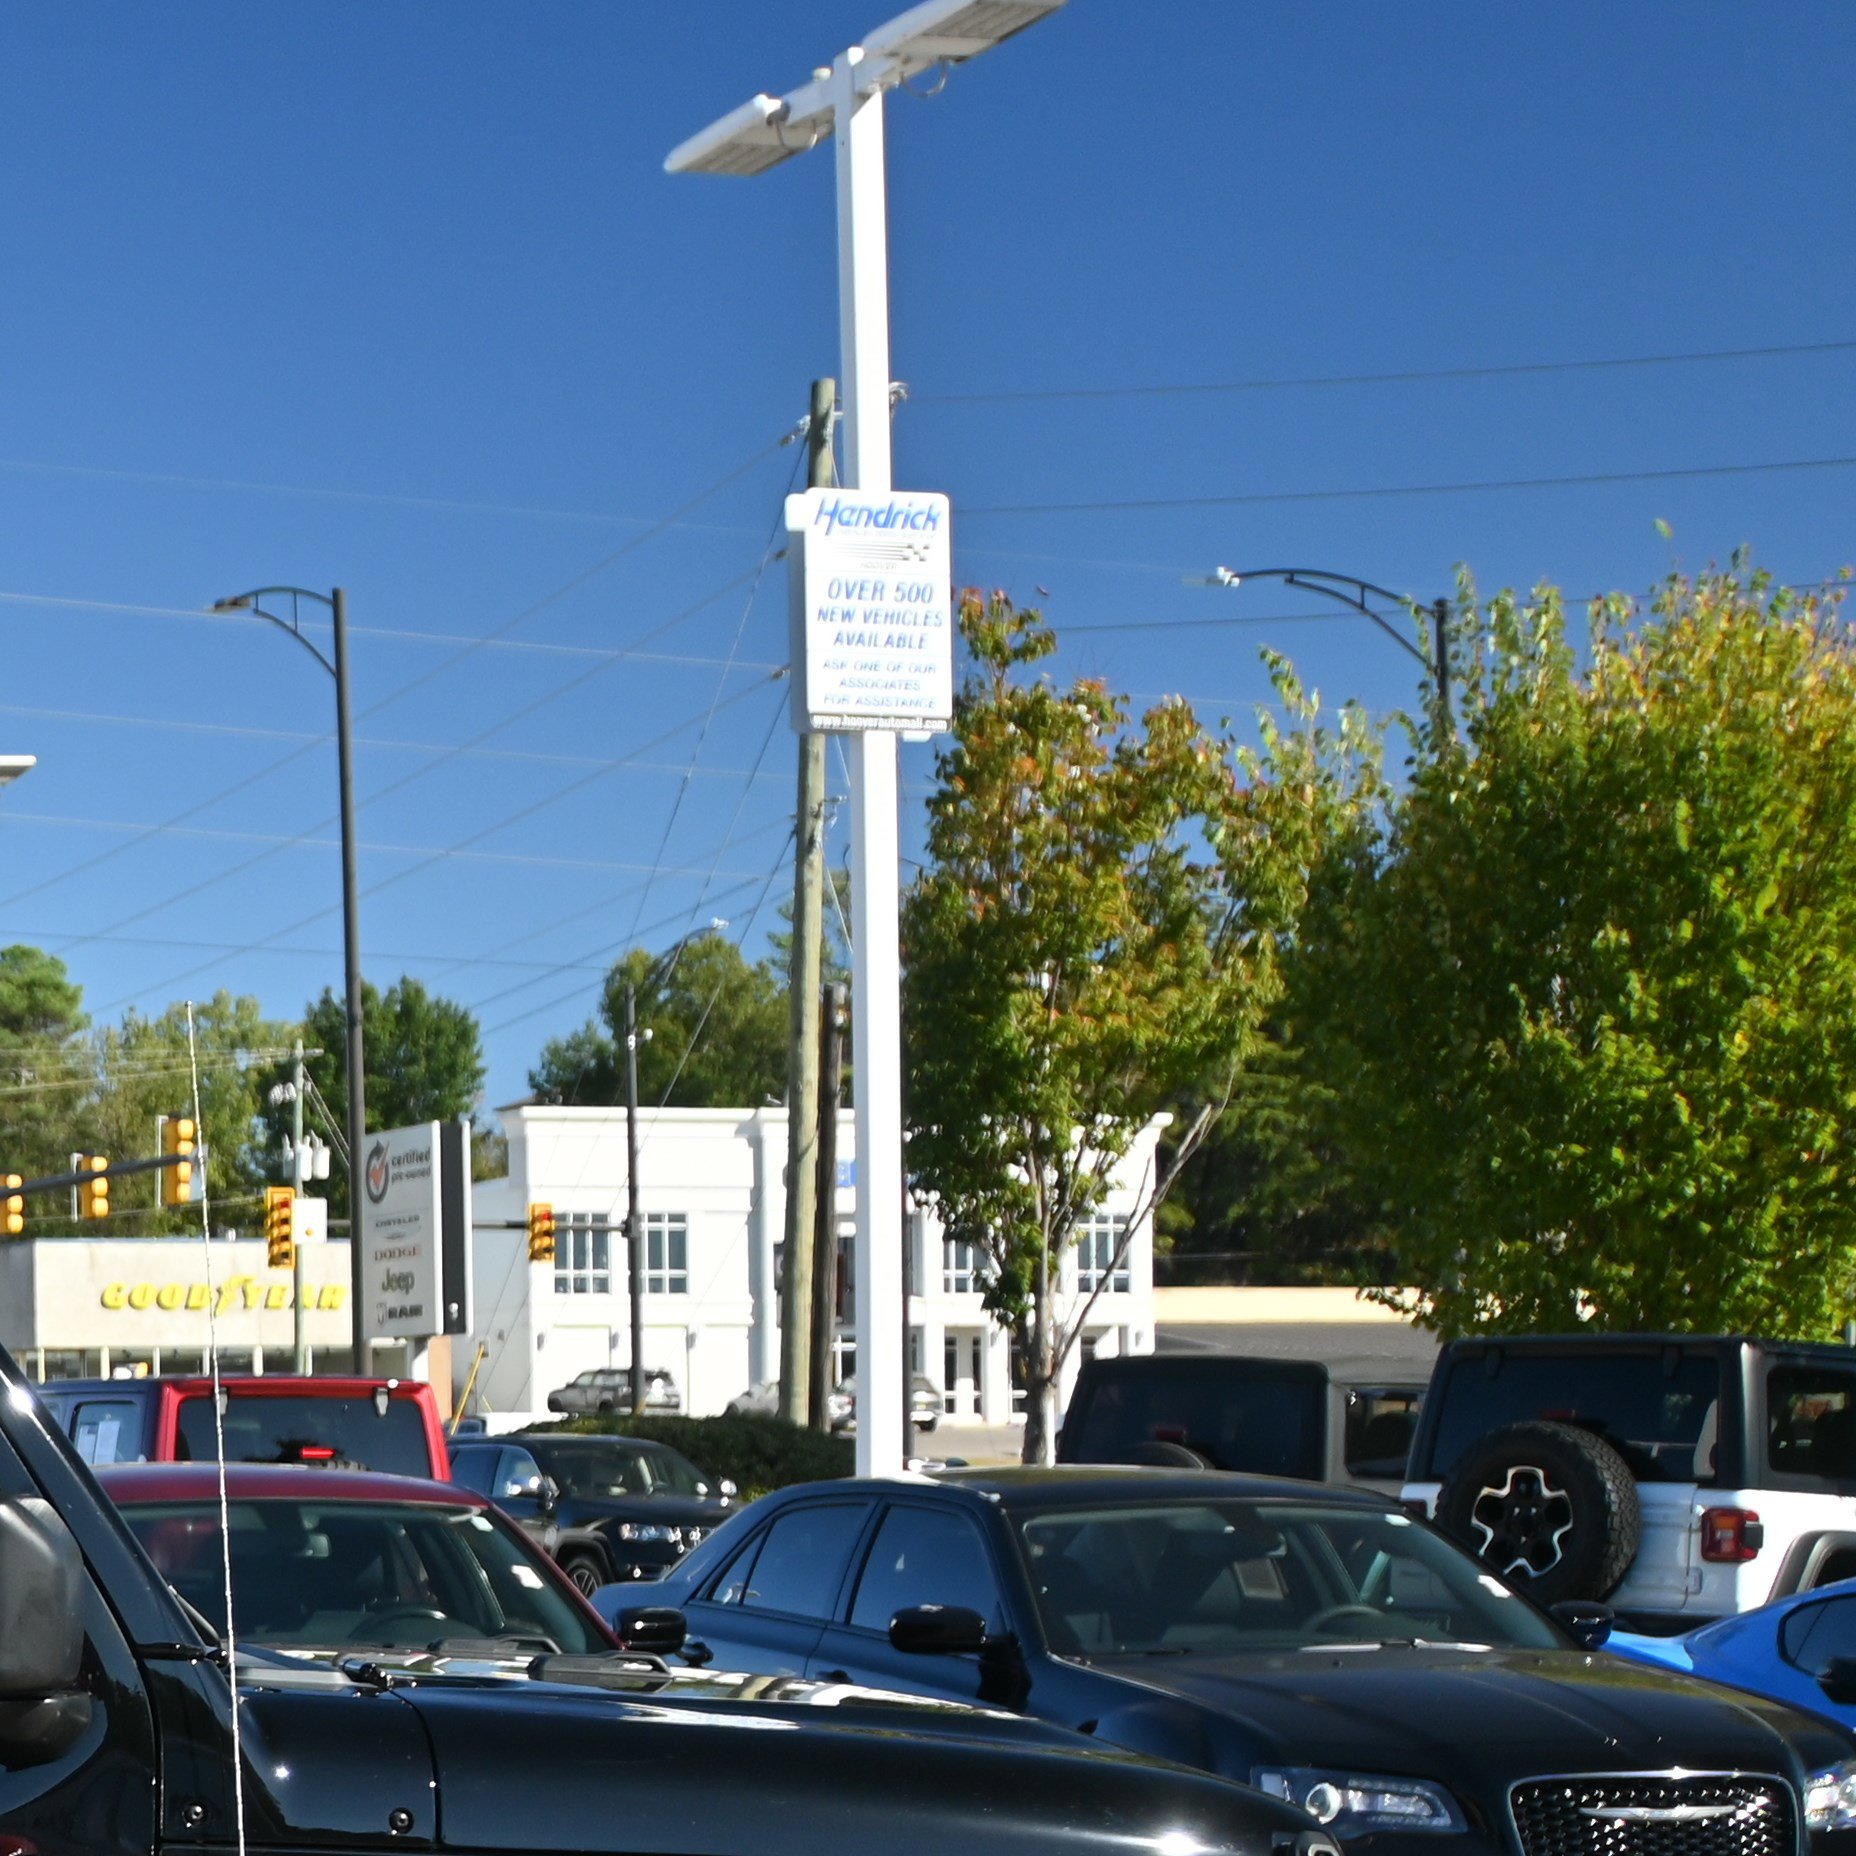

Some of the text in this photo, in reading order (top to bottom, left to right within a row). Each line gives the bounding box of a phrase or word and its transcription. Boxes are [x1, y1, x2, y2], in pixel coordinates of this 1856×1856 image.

[814, 496, 941, 536] Hendrick
[828, 578, 934, 604] OVER 500
[817, 606, 943, 627] NEW VEHICLES
[833, 630, 928, 650] AVAILABLE
[822, 659, 937, 674] ASK ONE OF OUR
[839, 677, 921, 691] ASSOCIATES
[824, 693, 936, 709] FOR ASSISTANCE
[813, 715, 948, 730] www.hooverautomall.com
[391, 1147, 431, 1167] certified
[391, 1166, 431, 1184] pre-owned
[375, 1214, 420, 1228] CHRYSLER
[374, 1246, 421, 1262] DODGE
[381, 1267, 415, 1296] Jeep
[388, 1304, 423, 1319] RAM
